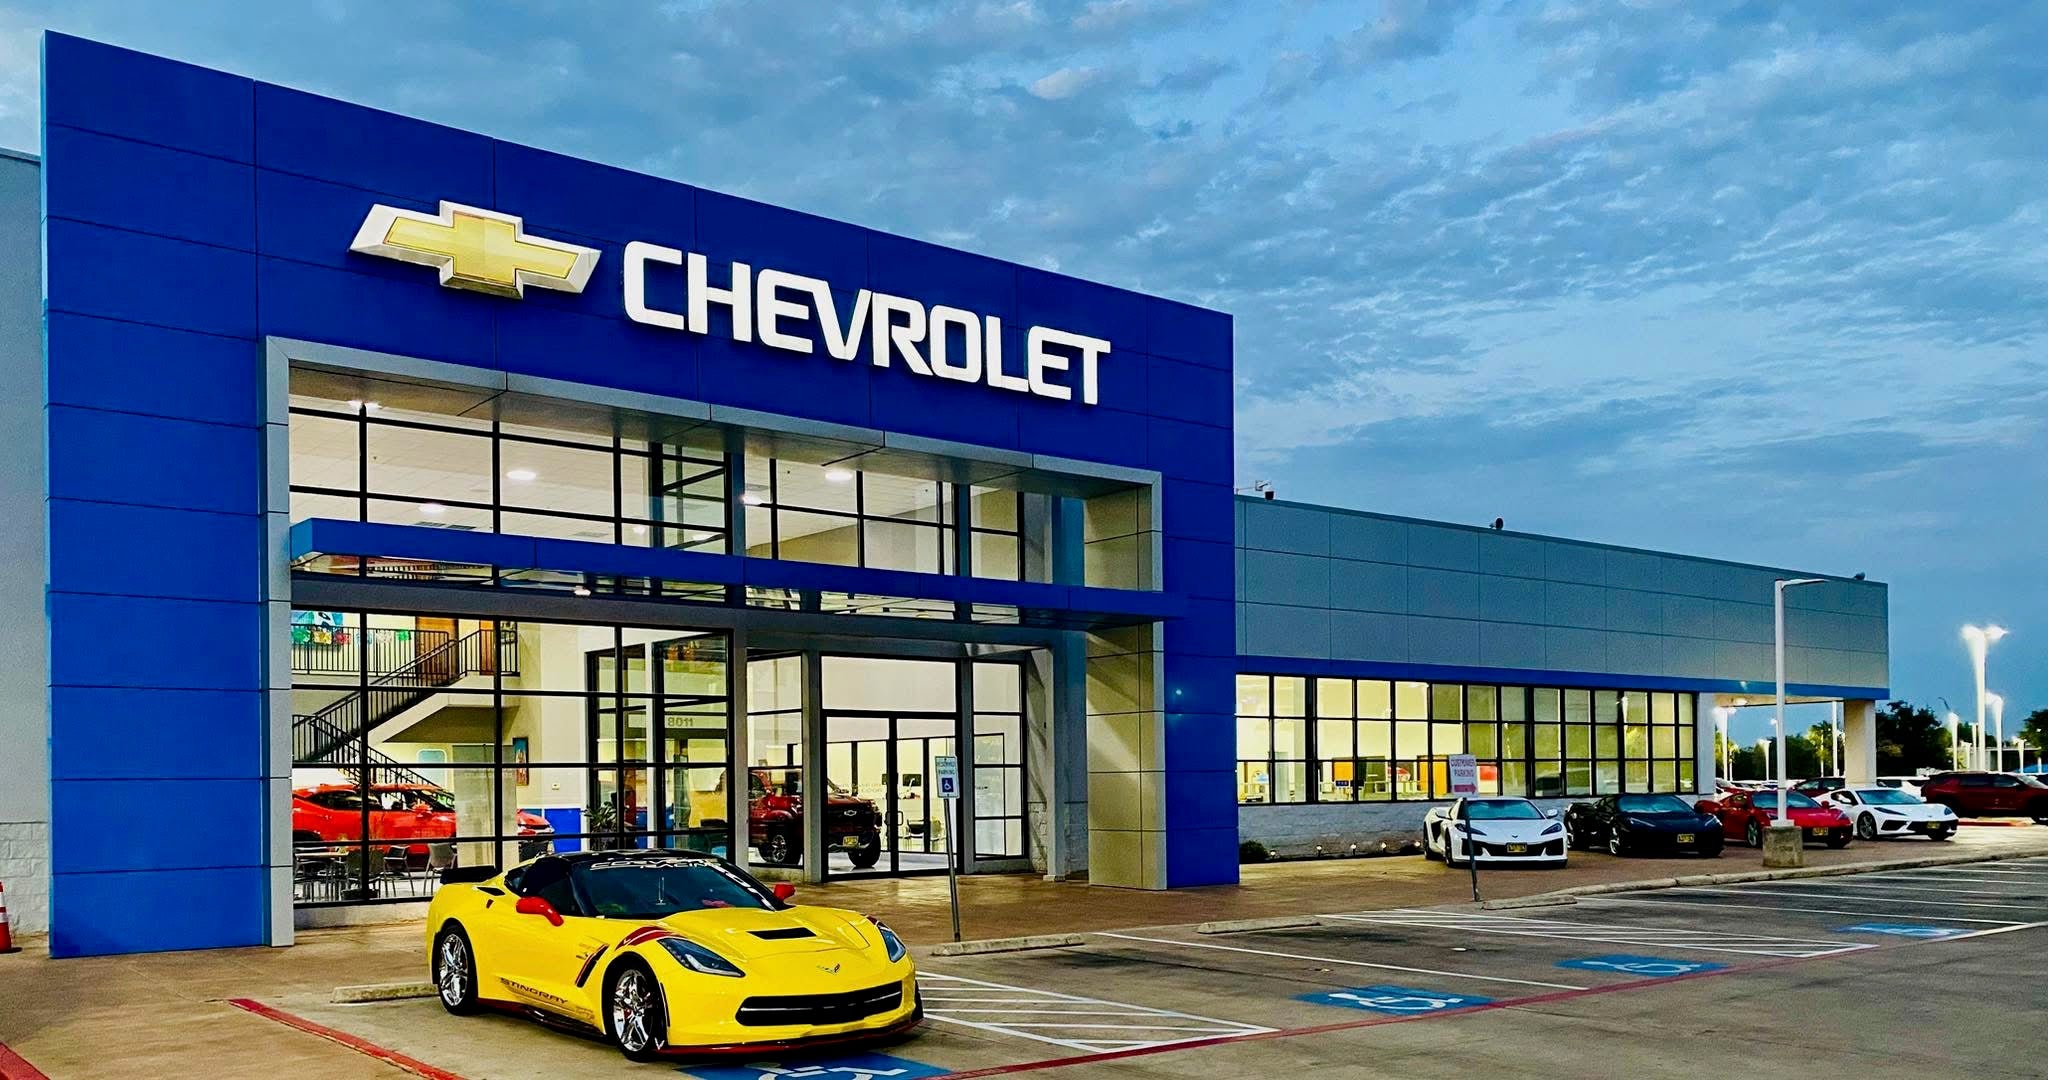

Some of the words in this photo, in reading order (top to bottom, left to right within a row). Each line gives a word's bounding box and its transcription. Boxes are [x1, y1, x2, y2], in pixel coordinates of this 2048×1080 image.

[623, 240, 1111, 405] CHEVROLET
[667, 716, 693, 726] 8011
[500, 977, 568, 1004] STINGRAY
